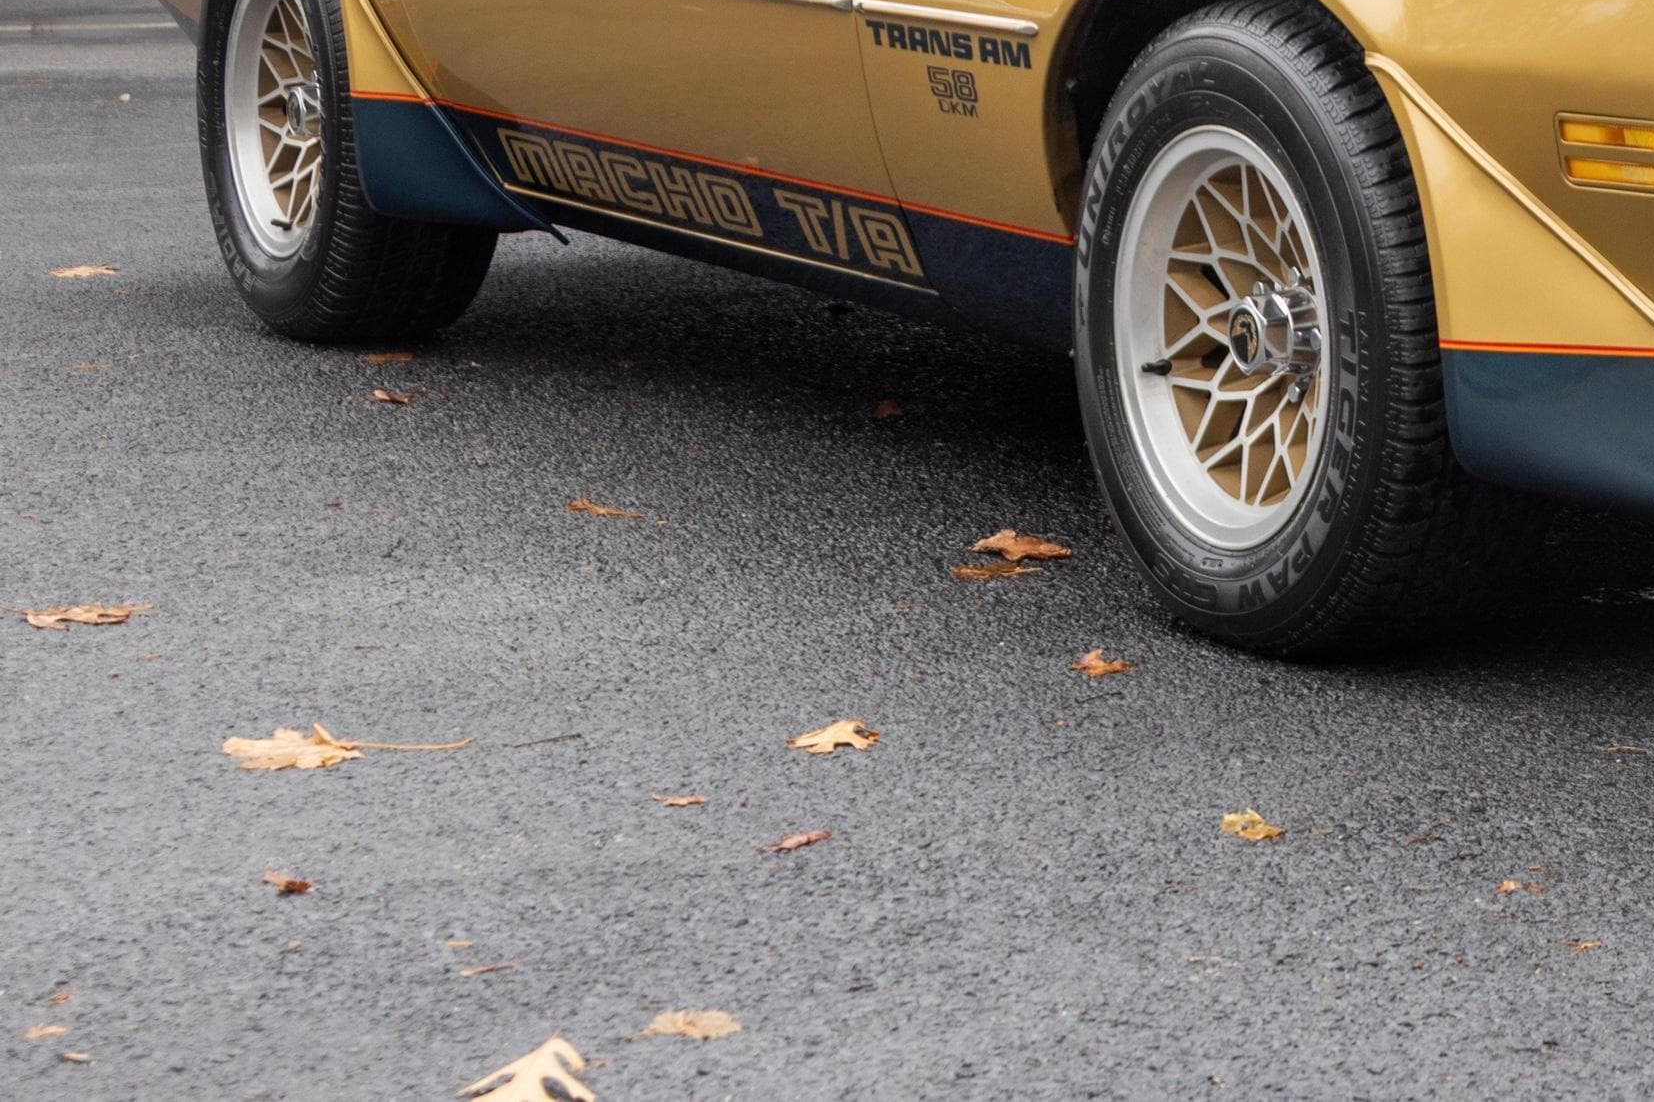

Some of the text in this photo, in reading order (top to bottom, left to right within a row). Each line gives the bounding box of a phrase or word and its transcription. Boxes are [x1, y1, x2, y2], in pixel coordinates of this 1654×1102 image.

[865, 19, 1032, 69] TRANS AM
[926, 64, 979, 103] 58
[497, 127, 925, 277] MACHO T/A
[1238, 308, 1359, 610] TIGER PAW
